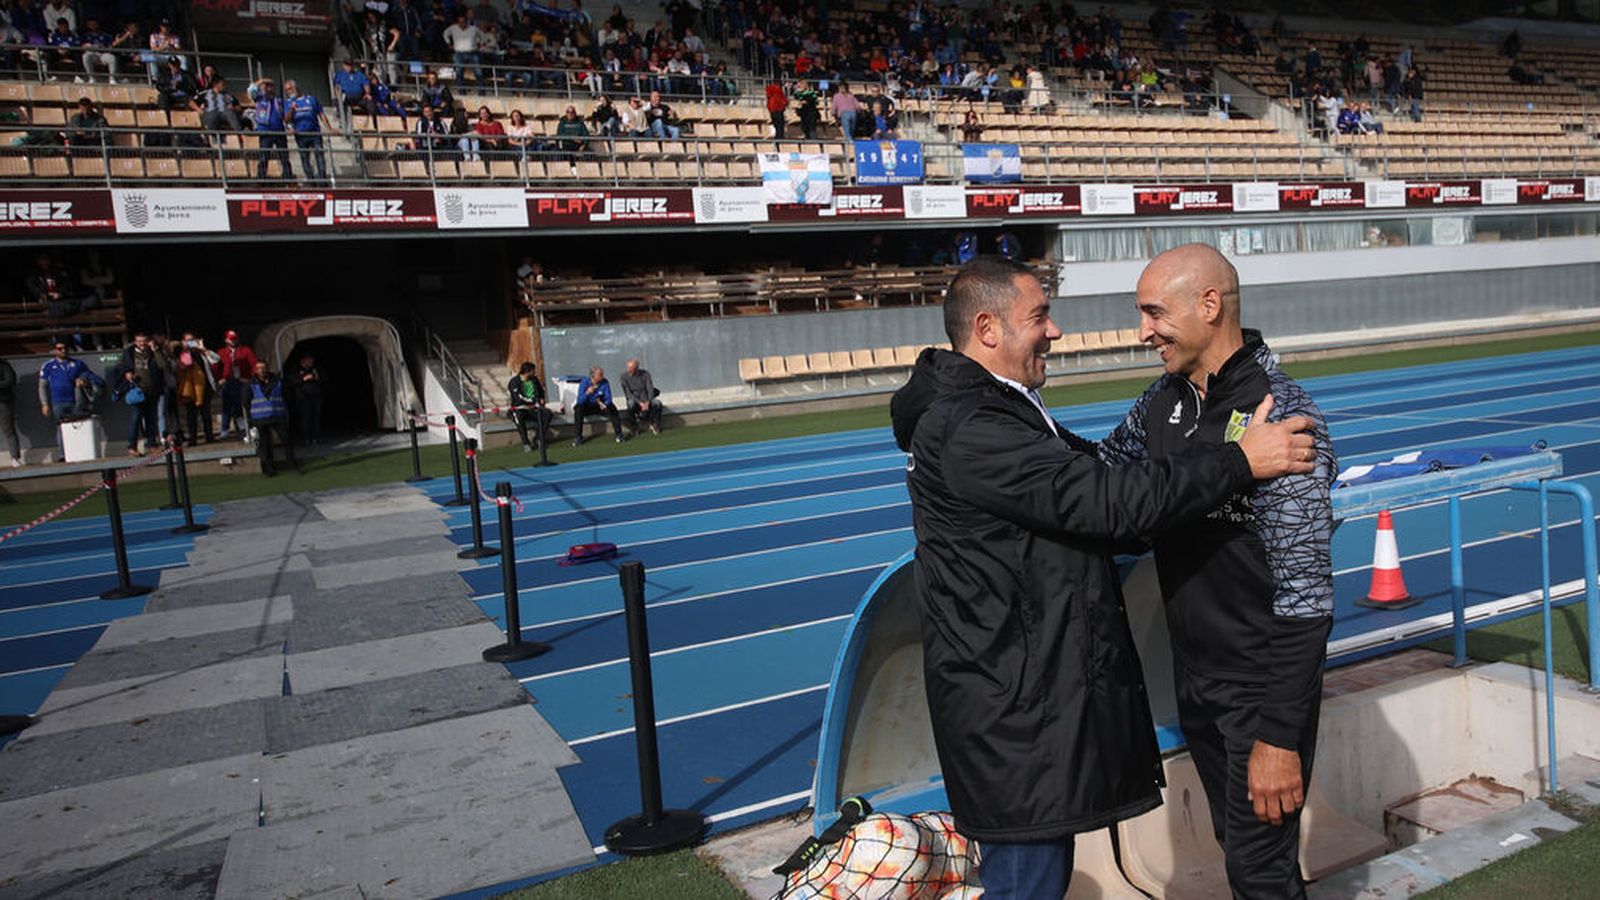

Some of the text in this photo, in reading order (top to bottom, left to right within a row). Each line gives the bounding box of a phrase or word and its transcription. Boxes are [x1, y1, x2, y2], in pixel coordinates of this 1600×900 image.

[538, 197, 668, 221] PLAY JEREZ
[973, 194, 1015, 207] PLAY
[1008, 192, 1064, 213] JEREZ
[1139, 192, 1177, 204] PLAY
[1170, 190, 1218, 210] JEREZ
[241, 199, 403, 225] PLAY JEREZ
